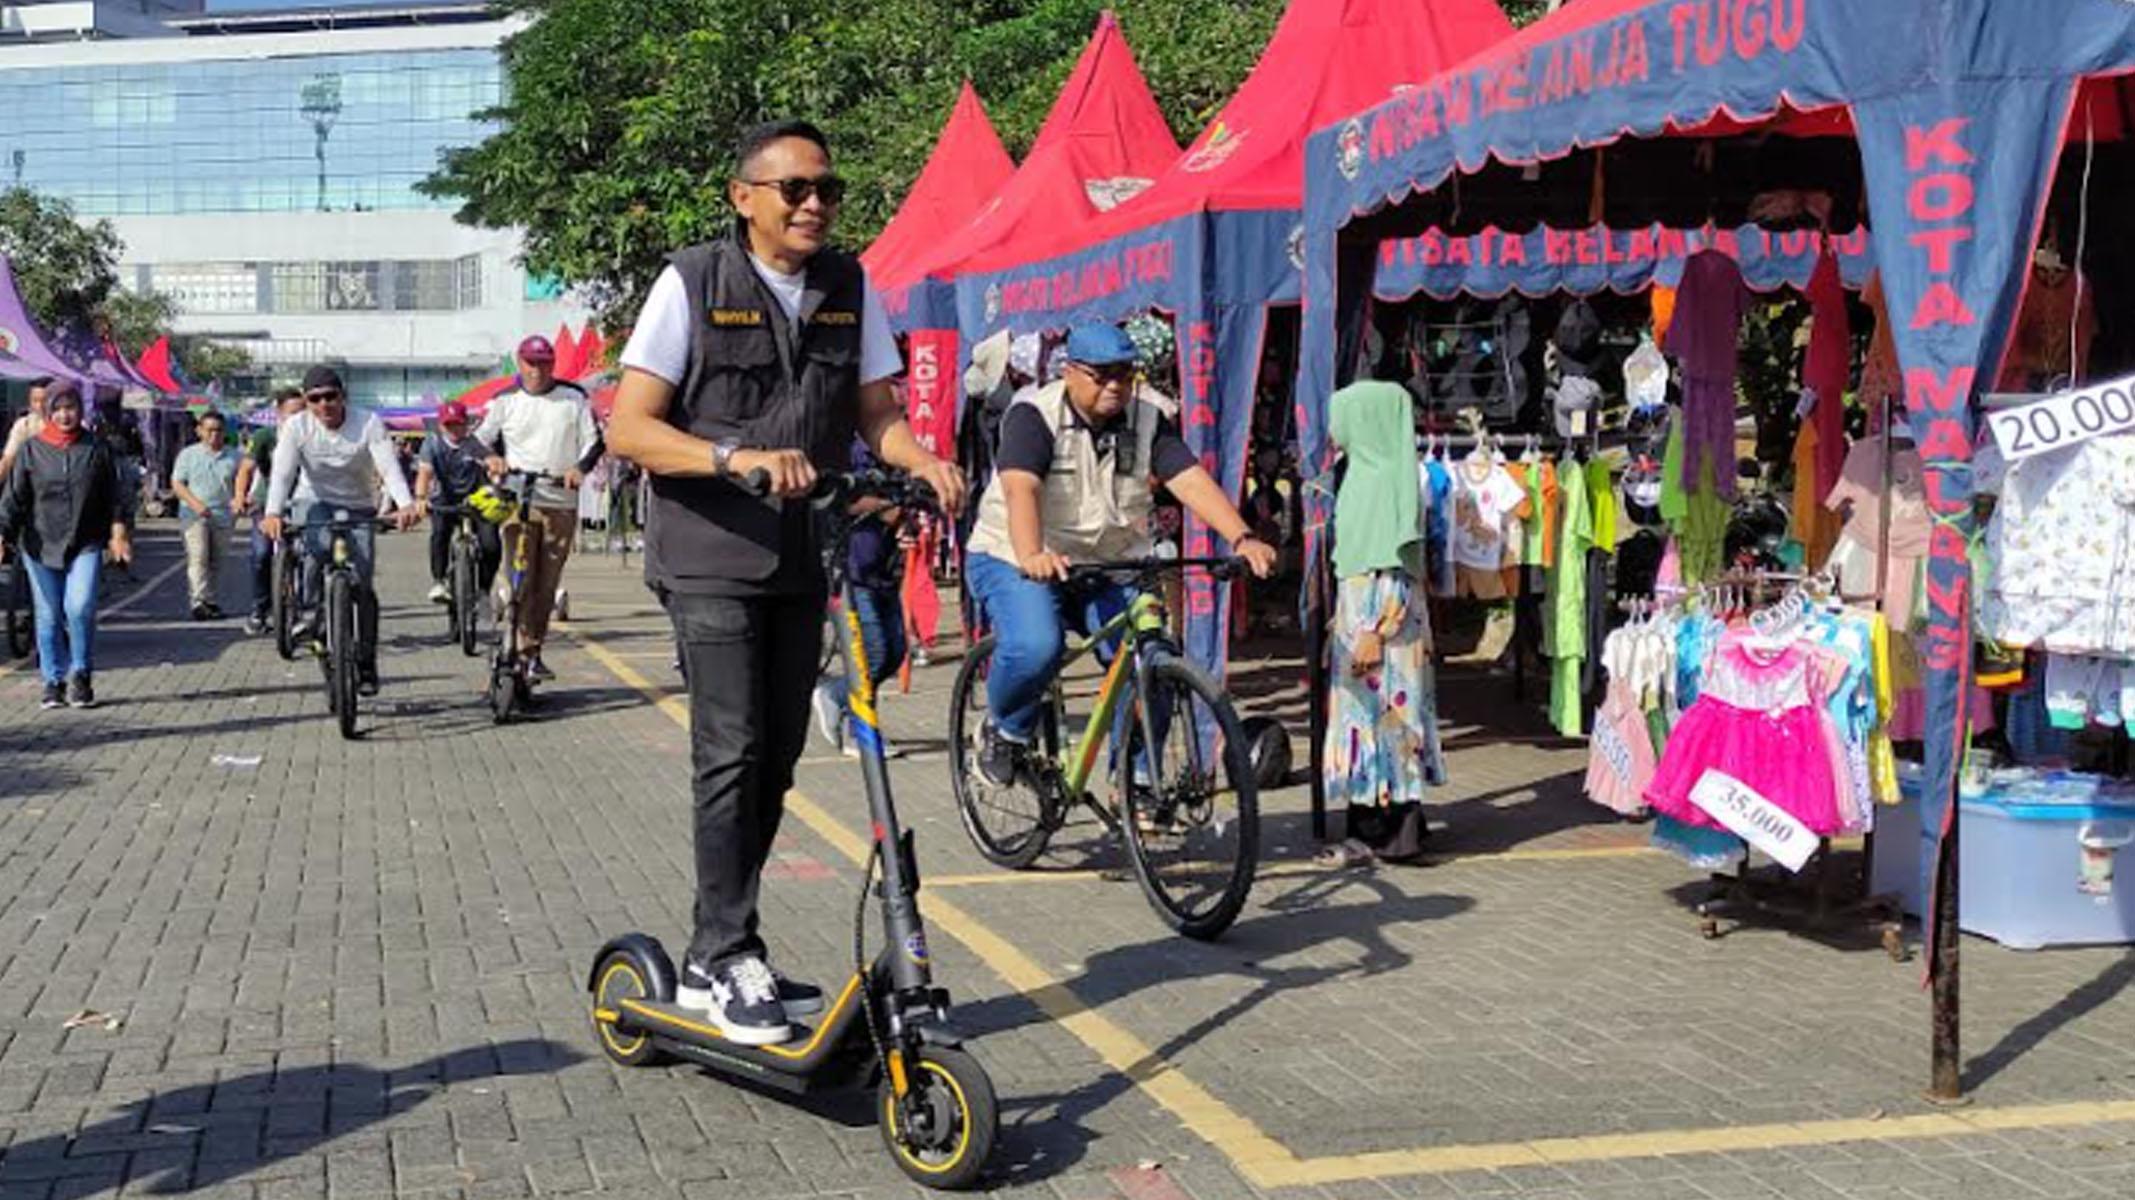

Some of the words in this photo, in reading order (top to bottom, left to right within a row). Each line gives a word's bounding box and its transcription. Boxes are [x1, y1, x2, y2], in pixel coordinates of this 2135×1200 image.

[1669, 0, 1805, 74] TUGU
[1904, 117, 1976, 330] KOTA
[915, 344, 939, 421] KOTA
[1188, 320, 1216, 426] KOTA
[1720, 786, 1795, 843] 35.000
